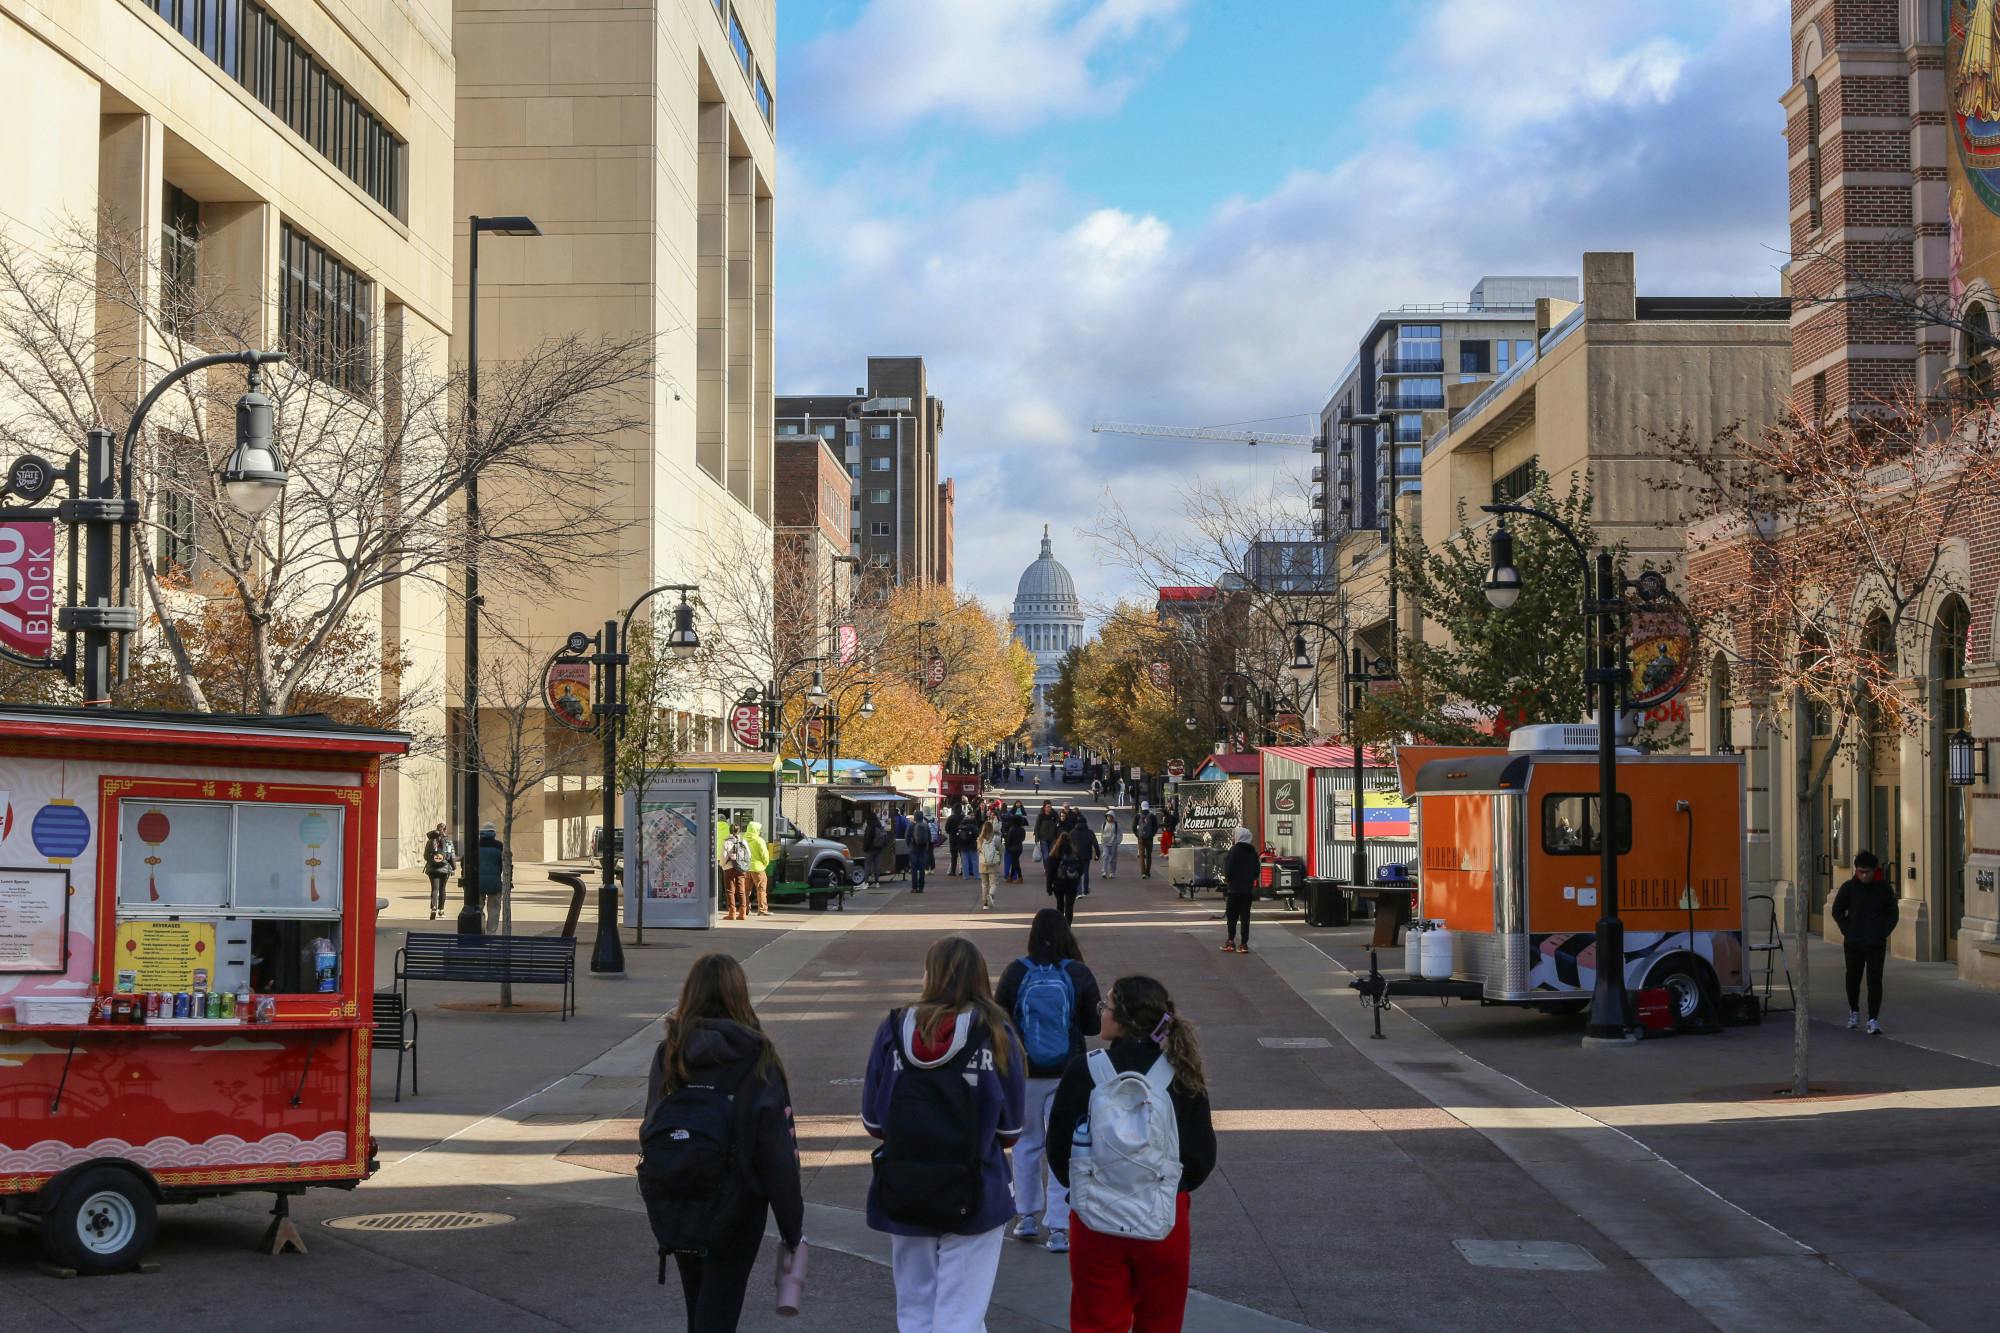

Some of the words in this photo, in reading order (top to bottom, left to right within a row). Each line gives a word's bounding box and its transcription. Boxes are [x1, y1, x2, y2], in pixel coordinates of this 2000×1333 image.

[16, 470, 39, 481] STATE
[26, 547, 51, 635] BLOCK
[736, 708, 751, 740] 700
[751, 713, 759, 740] BLOCK
[1184, 818, 1216, 829] KOREAN
[1217, 817, 1238, 828] TACO
[1194, 805, 1227, 817] BULGOGI
[1622, 879, 1678, 907] IBACHI
[1702, 879, 1728, 906] HUT
